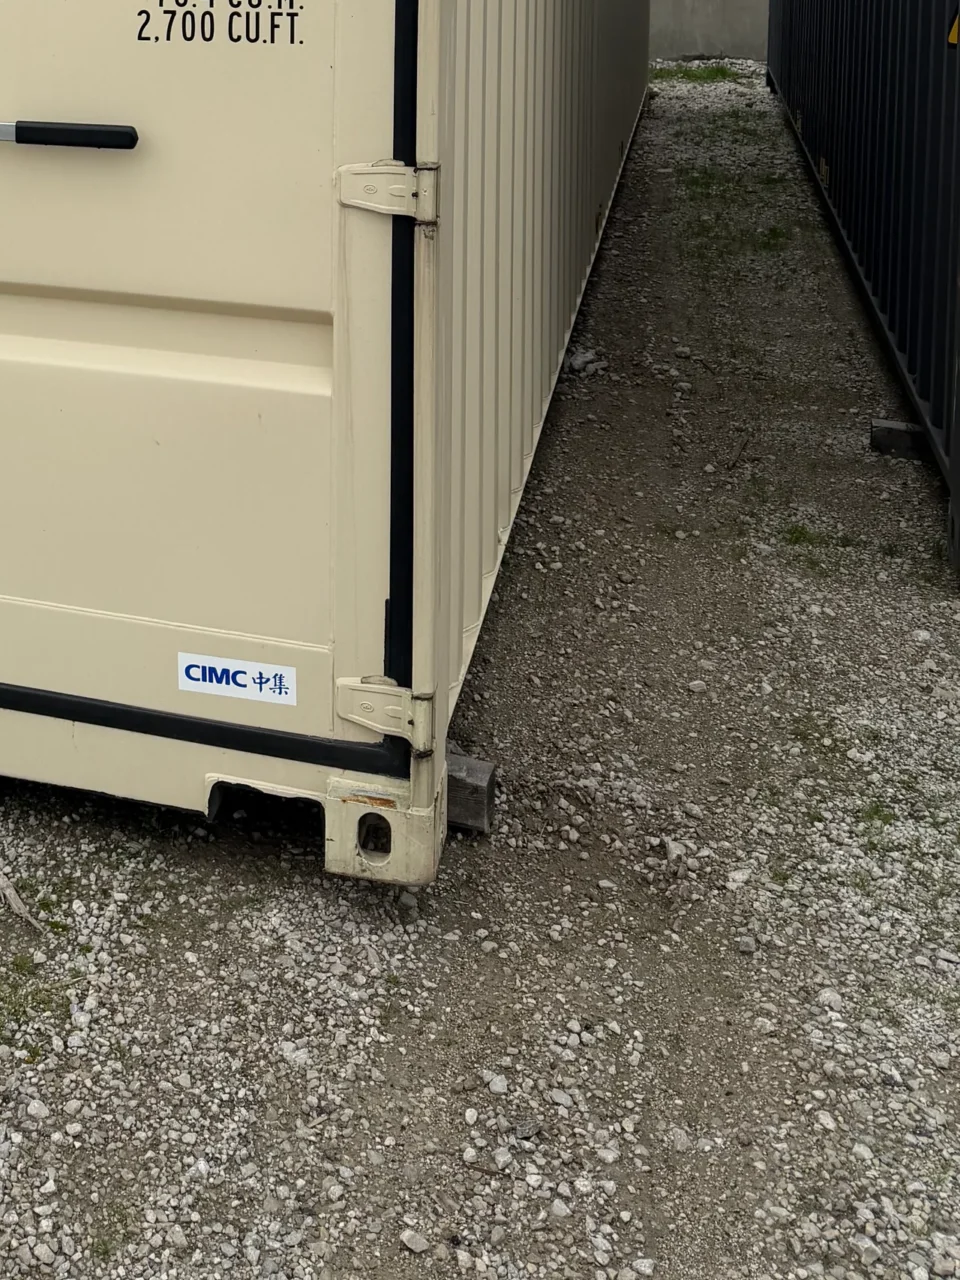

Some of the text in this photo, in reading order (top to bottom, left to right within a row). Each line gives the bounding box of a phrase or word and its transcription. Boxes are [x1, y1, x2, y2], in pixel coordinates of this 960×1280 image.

[137, 9, 215, 43] 2,700
[184, 664, 289, 696] CIMC 中集
